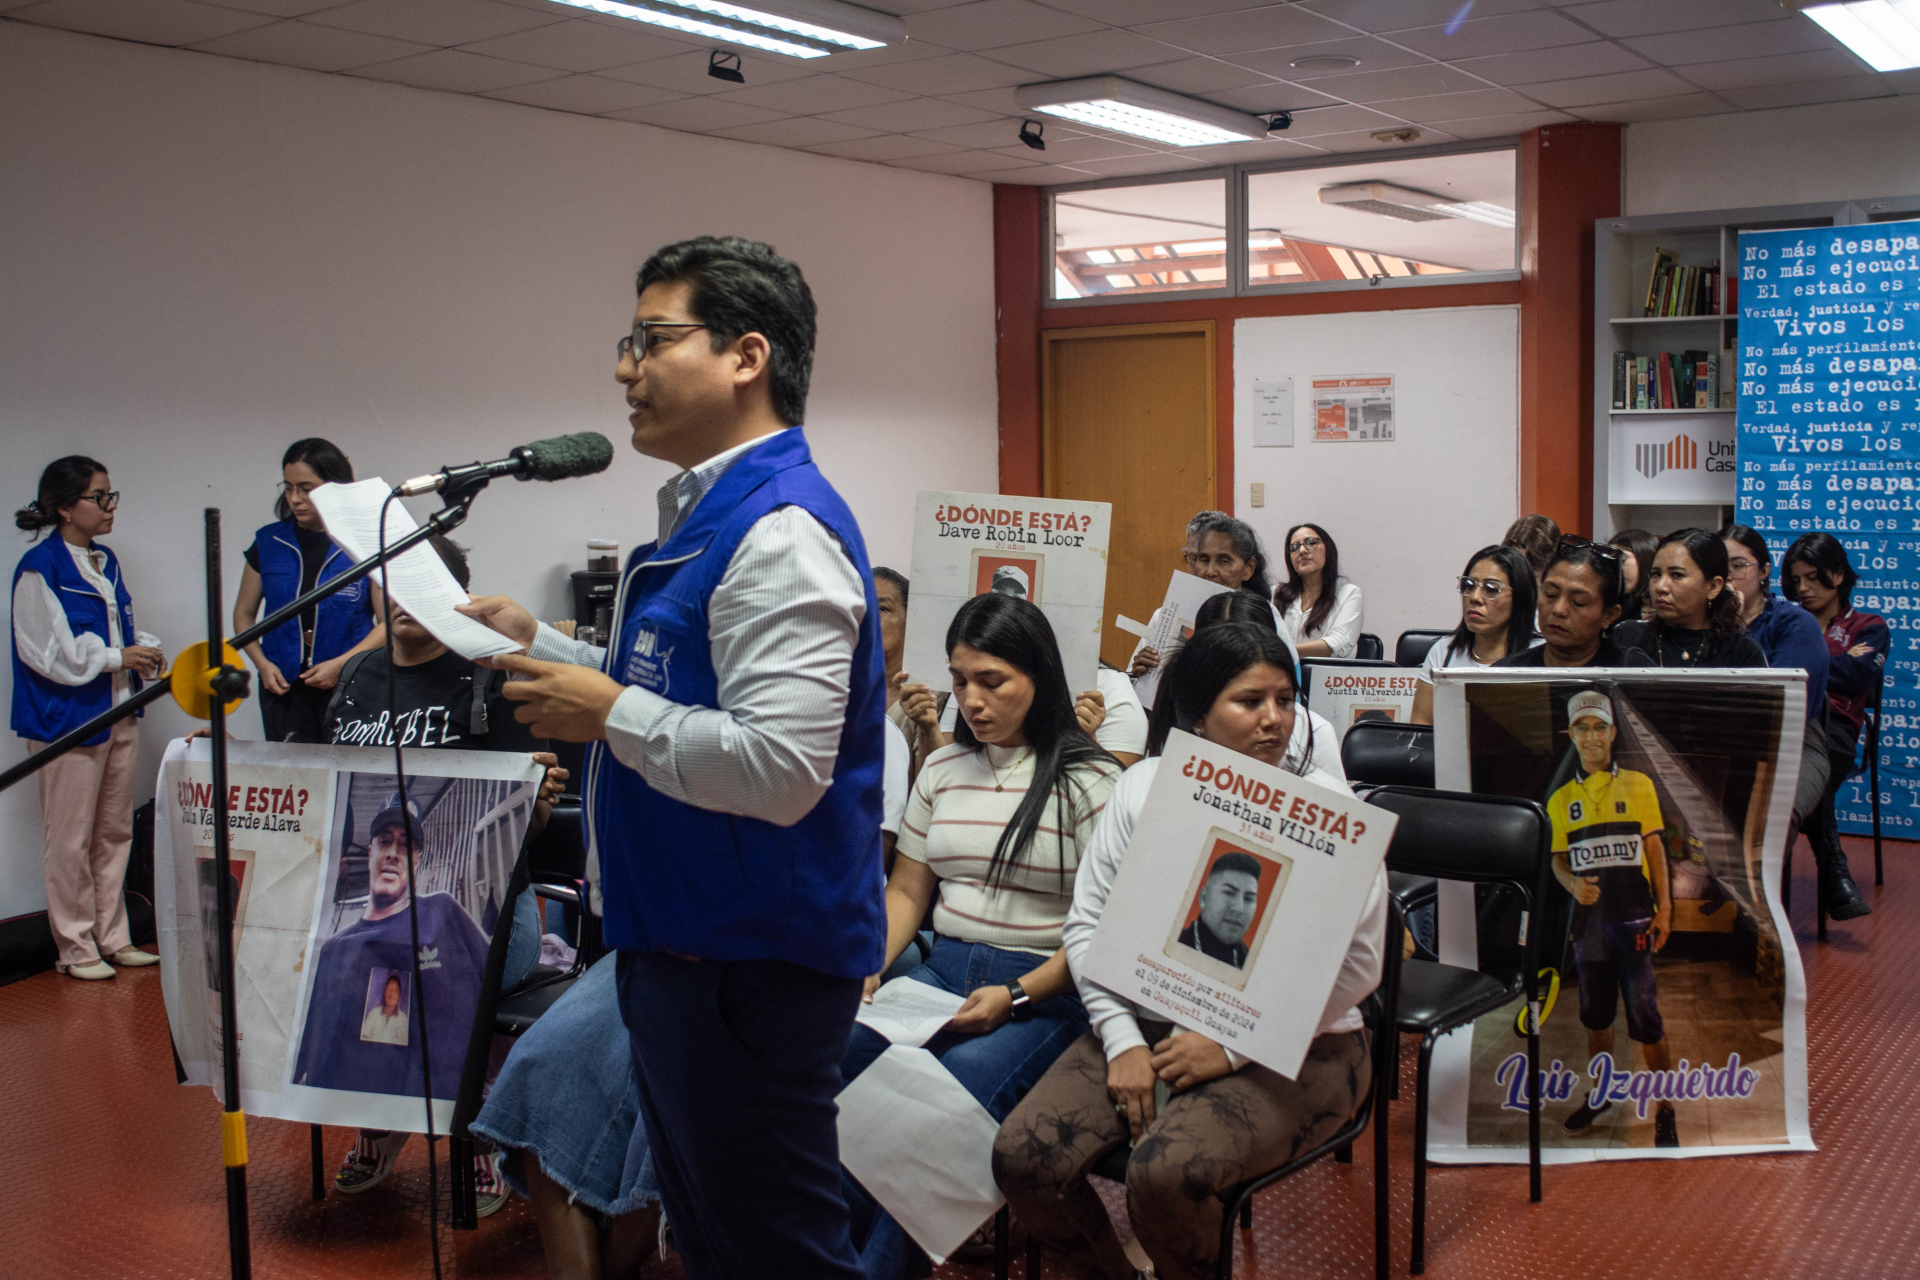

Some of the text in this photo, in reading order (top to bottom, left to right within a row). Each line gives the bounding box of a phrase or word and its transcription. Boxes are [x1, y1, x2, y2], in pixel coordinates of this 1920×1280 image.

[1746, 247, 1768, 260] No
[1781, 240, 1816, 258] más
[1743, 256, 1919, 280] No más ejecuci
[1756, 280, 1902, 298] El estado es
[1744, 308, 1799, 318] Verdad,
[1808, 303, 1875, 318] justicia
[1884, 302, 1894, 314] y
[1774, 317, 1904, 336] Vivos los
[1746, 346, 1763, 357] No
[1772, 343, 1798, 356] más
[1744, 356, 1920, 376] No más desapa
[1742, 376, 1920, 396] No más ejecuci
[1755, 399, 1900, 414] El estado es
[1743, 423, 1798, 435] Verdad,
[1807, 422, 1872, 435] justicia
[1881, 421, 1892, 434] y
[1709, 440, 1736, 456] Uni
[1772, 436, 1902, 452] Vivos los
[1744, 462, 1761, 472] No
[1770, 459, 1796, 472] más
[1742, 478, 1766, 491] No
[1777, 474, 1812, 491] más
[1740, 497, 1764, 510] No
[1776, 493, 1812, 510] más
[936, 504, 1091, 532] ¿DÓNDE ESTÁ?
[1753, 516, 1776, 530] El
[1790, 516, 1860, 530] estado
[1875, 518, 1897, 530] es
[939, 522, 1084, 547] Dave Robin Loor
[995, 542, 1005, 550] 20
[1858, 554, 1898, 570] los
[1325, 675, 1419, 688] ¿DÓNDE EST
[1328, 688, 1358, 696] Justin
[1360, 688, 1401, 696] Valverde
[178, 777, 308, 816] ¿DÓNE ESTÁ?
[1182, 755, 1366, 844] ¿DÓNDE ESTÁ?
[200, 808, 260, 830] Vaerde
[1570, 802, 1582, 820] 8
[1193, 785, 1336, 856] Jonathan Villón
[1252, 828, 1275, 844] años
[1570, 840, 1638, 866] Tommy
[1137, 953, 1262, 1018] desaparecido por militares
[1135, 968, 1146, 978] el
[1159, 979, 1170, 990] de
[1171, 984, 1218, 1013] diciembre
[1219, 1006, 1230, 1019] de
[1231, 1015, 1256, 1032] 2024
[1204, 1016, 1238, 1039] Guayas
[1588, 1052, 1761, 1120] Izquierdo
